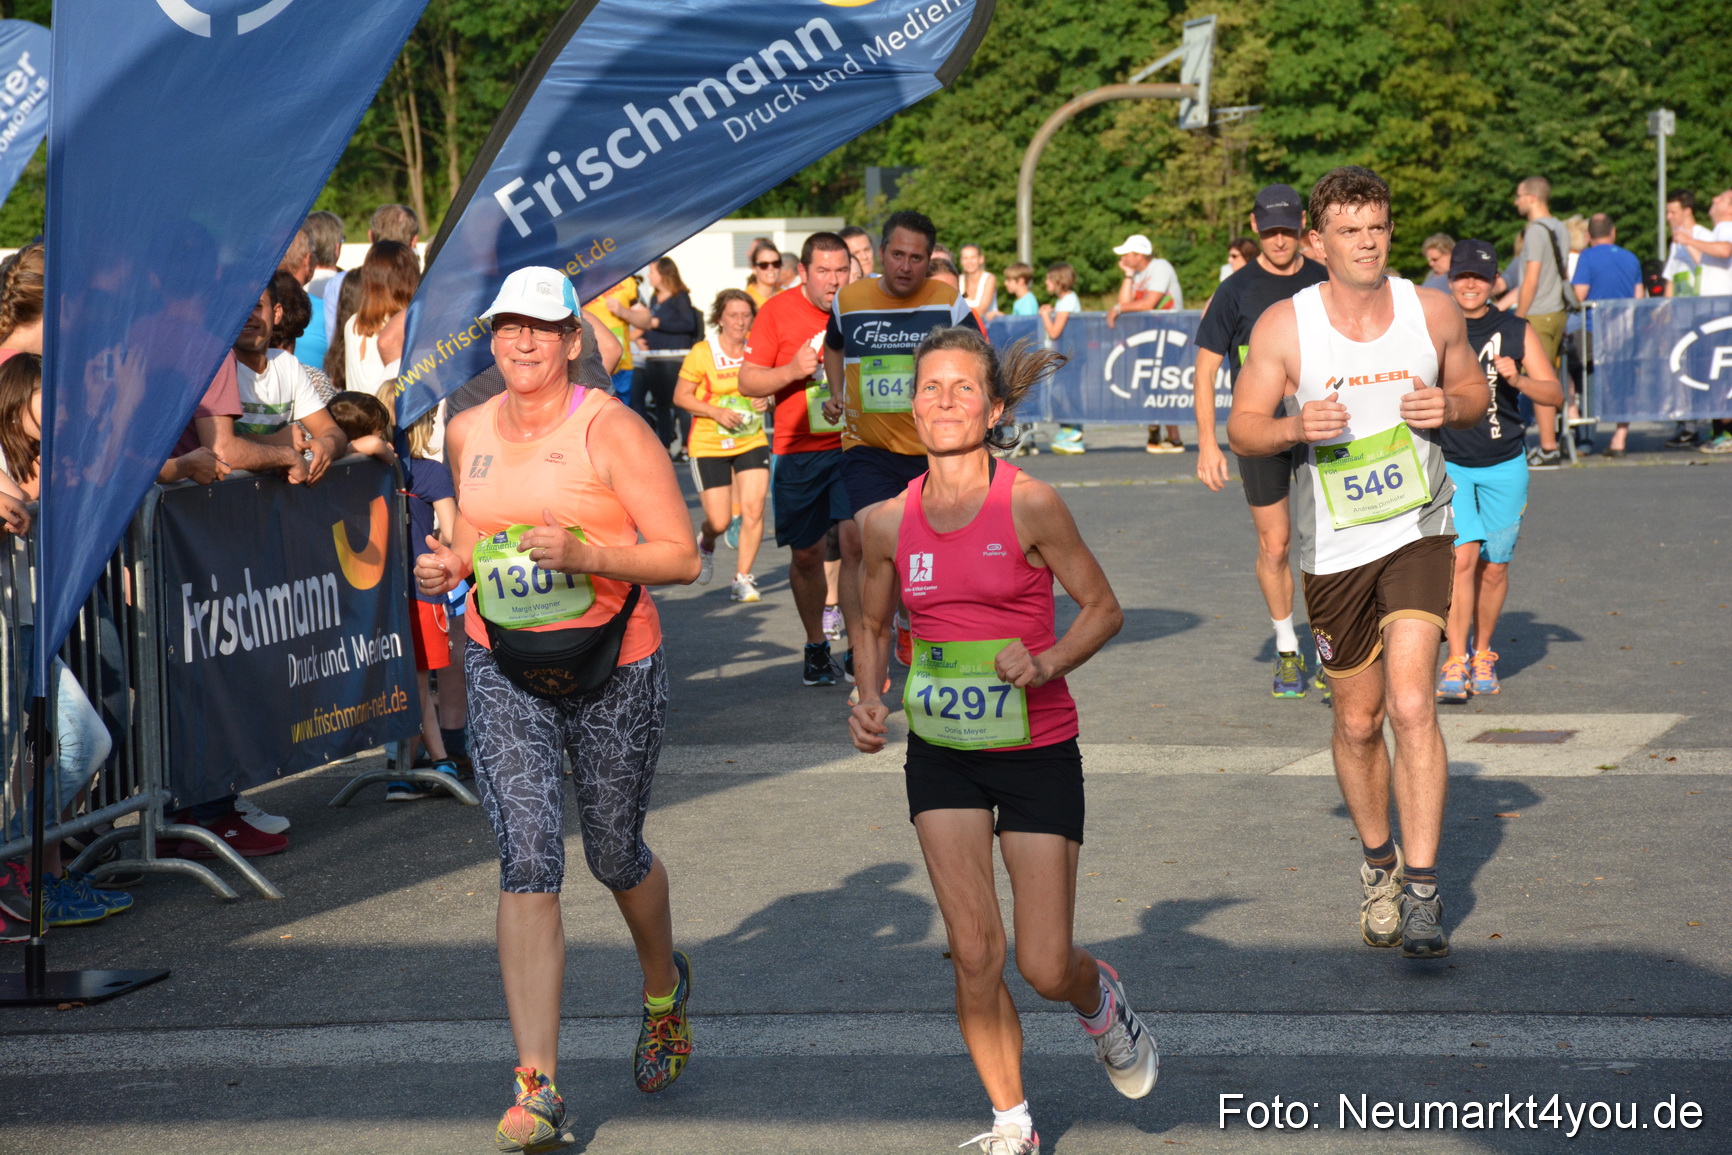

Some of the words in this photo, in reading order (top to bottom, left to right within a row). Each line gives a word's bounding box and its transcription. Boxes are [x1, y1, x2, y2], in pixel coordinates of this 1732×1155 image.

[722, 84, 807, 143] Druck
[808, 53, 864, 91] und
[493, 17, 843, 238] Frischmann
[865, 330, 928, 342] Fischer
[1131, 359, 1232, 390] Fisc
[1348, 370, 1415, 386] KLEBL
[1343, 463, 1403, 501] 546
[1353, 504, 1378, 513] Andreas
[1378, 493, 1406, 508] Dirnhofer
[486, 541, 519, 551] firmenla
[488, 563, 575, 599] 1301
[182, 567, 341, 664] Frischmann
[512, 605, 532, 614] Margit
[533, 600, 560, 611] Wagner
[288, 645, 318, 688] Druck
[321, 637, 351, 678] und
[351, 627, 403, 669] Medien
[291, 685, 408, 744] www.frischmann-net.de
[917, 684, 1012, 720] 1297
[945, 726, 962, 735] Doris
